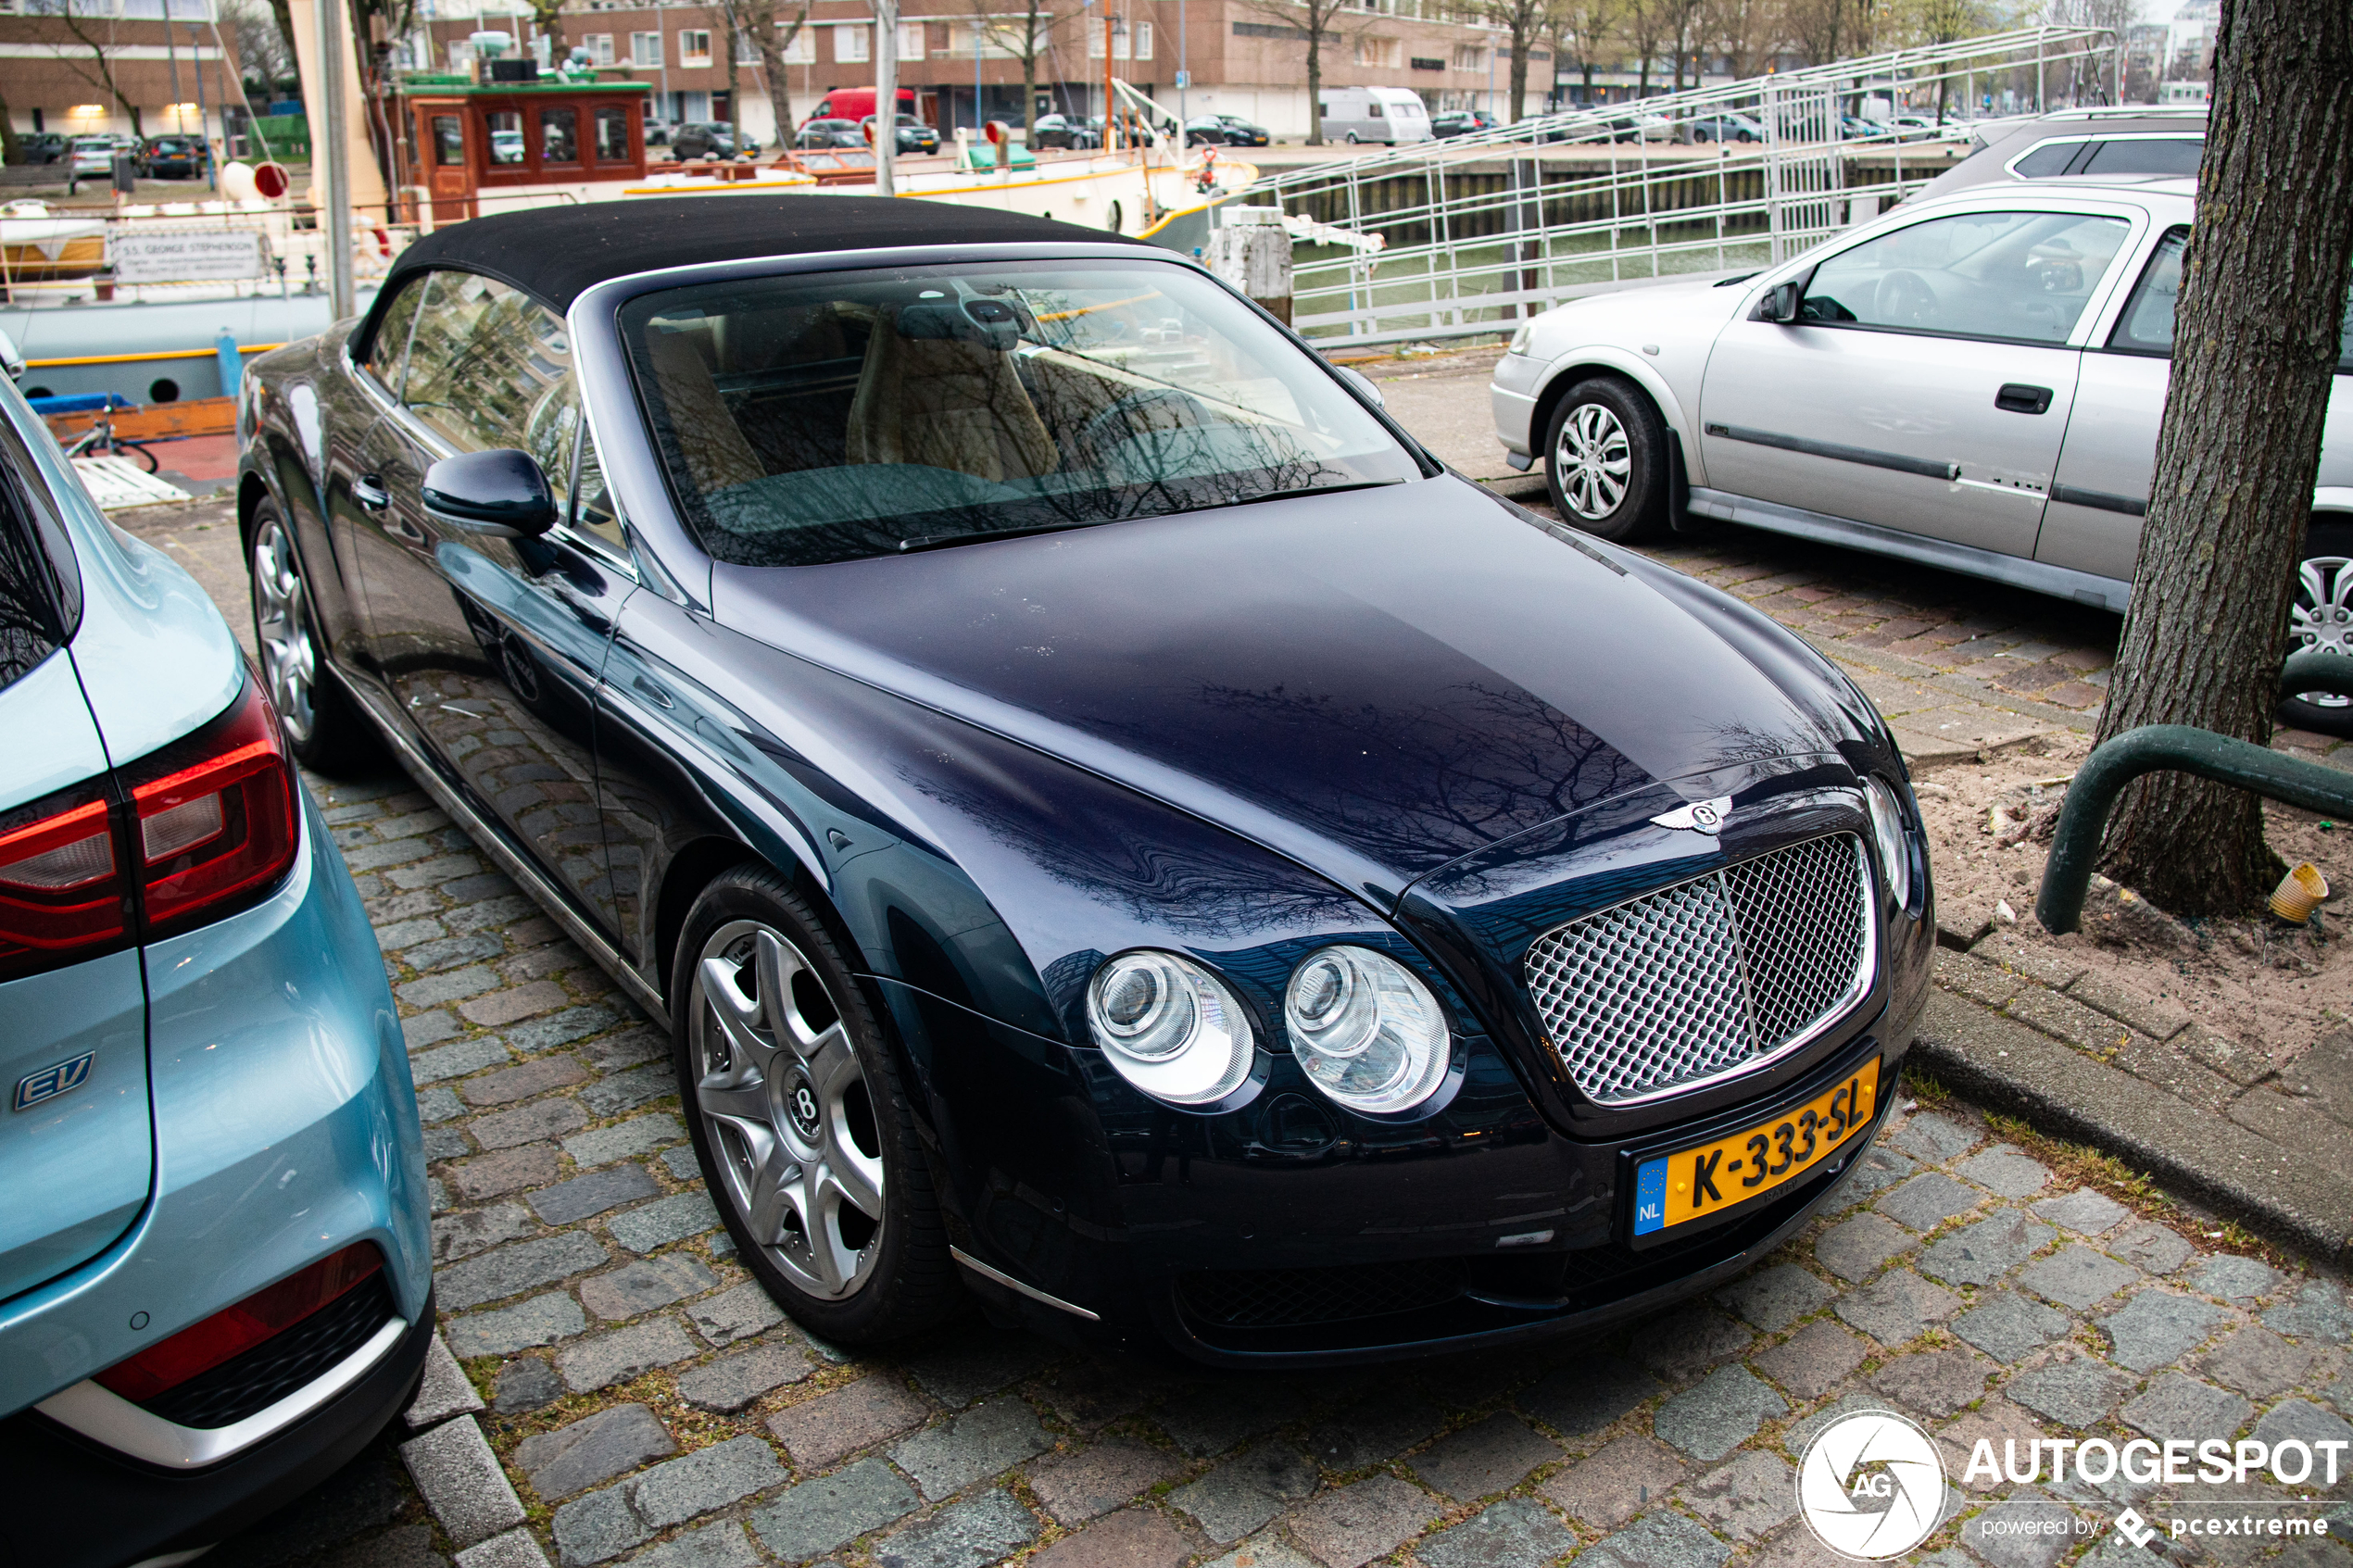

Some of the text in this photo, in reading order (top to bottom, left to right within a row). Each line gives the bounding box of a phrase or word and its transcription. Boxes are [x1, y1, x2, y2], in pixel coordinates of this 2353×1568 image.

[145, 243, 184, 254] GEORGE
[189, 242, 252, 252] STEPHENSON
[1695, 807, 1717, 824] B
[24, 1059, 88, 1102] EV
[797, 1088, 816, 1120] B
[1692, 1079, 1864, 1207] K-333-SL
[1639, 1203, 1660, 1222] NL
